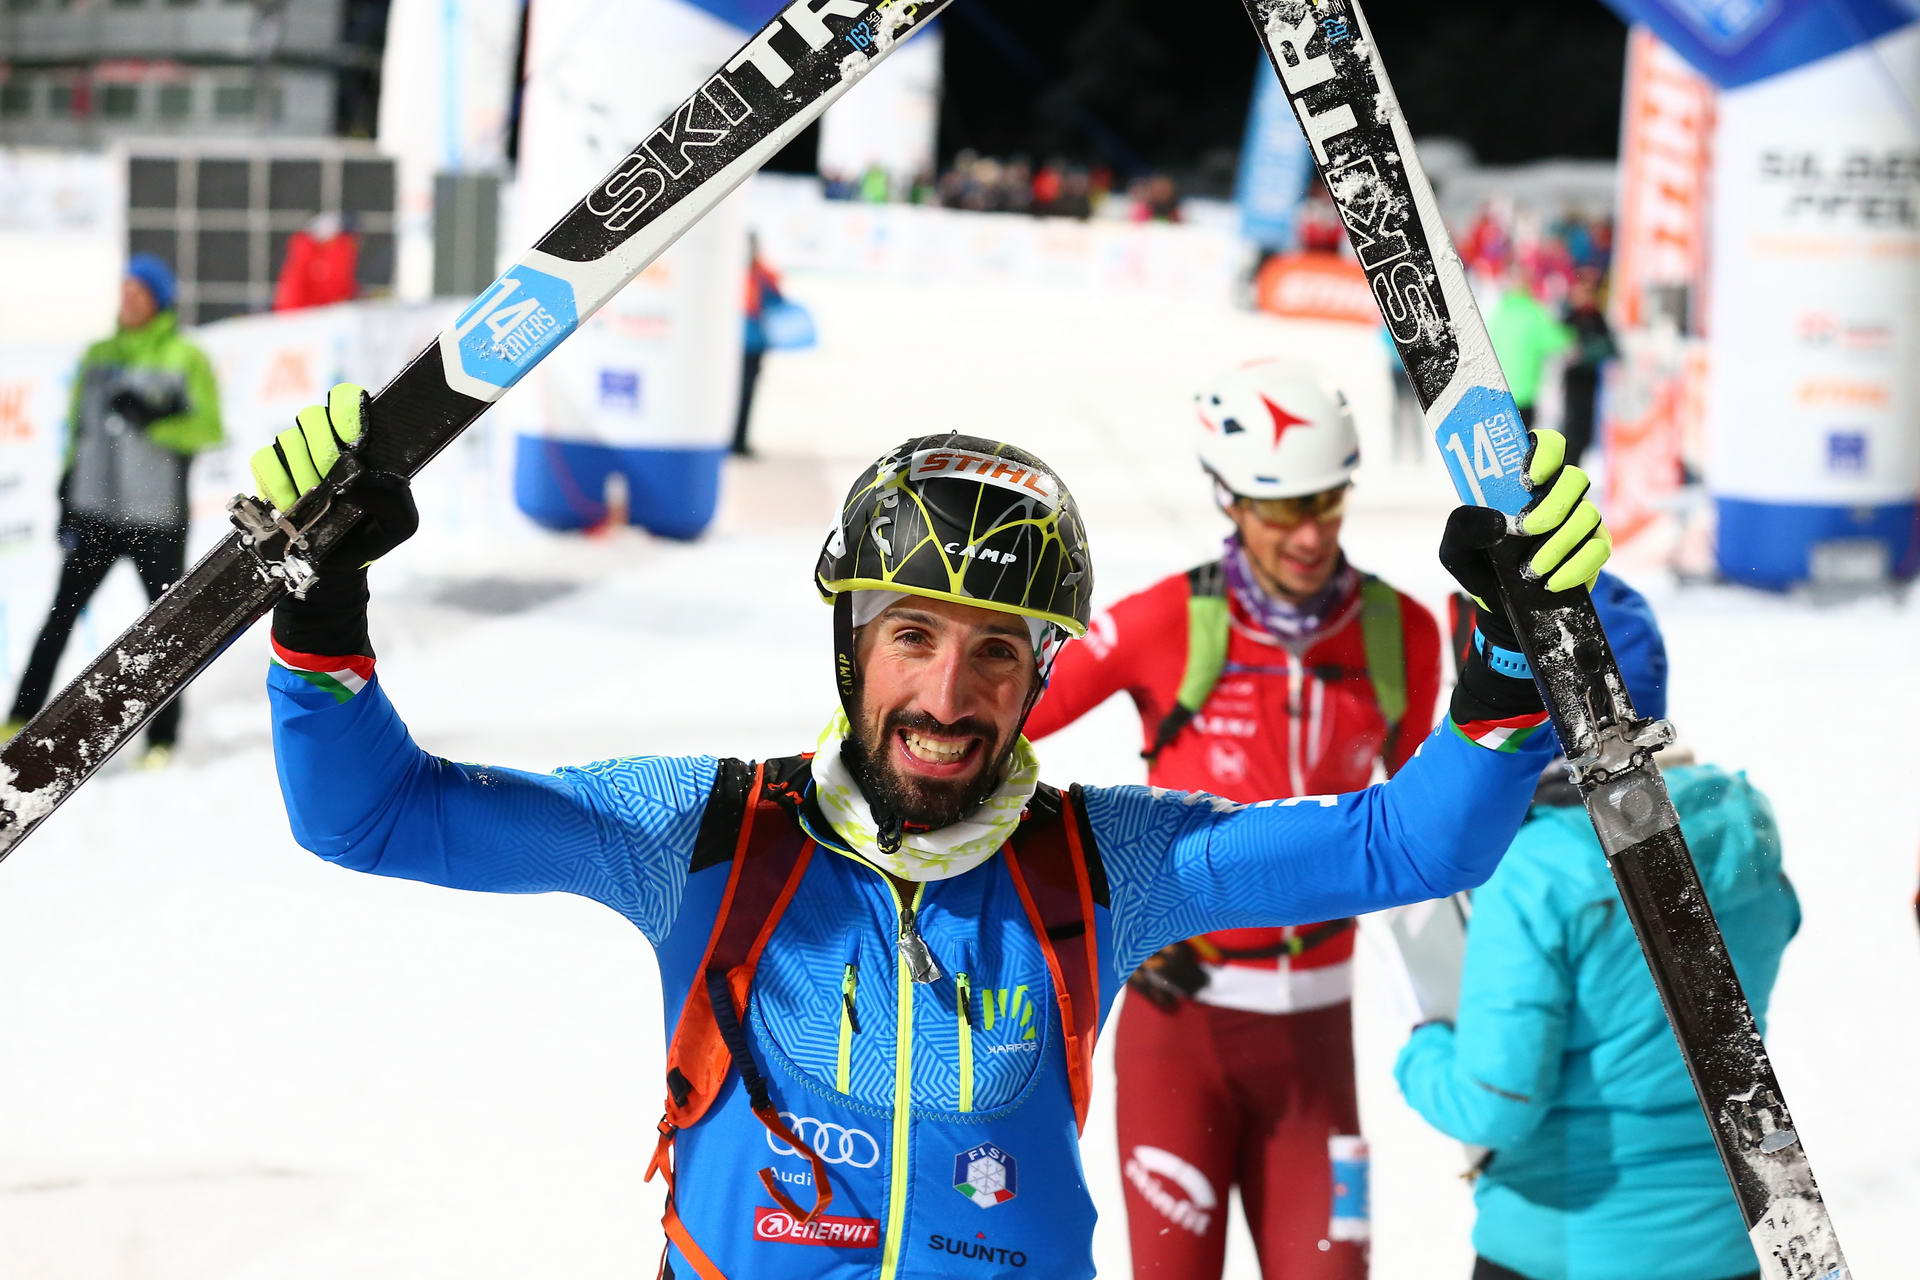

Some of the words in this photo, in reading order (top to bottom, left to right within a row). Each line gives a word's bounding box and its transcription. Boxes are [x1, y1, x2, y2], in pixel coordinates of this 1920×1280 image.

[845, 21, 874, 51] 162
[456, 278, 541, 342] 14
[502, 306, 556, 361] LAYERS
[1485, 413, 1522, 475] LAYERS
[918, 453, 1049, 497] STIHL
[1445, 421, 1504, 507] 14
[944, 542, 1016, 566] CAMP
[839, 653, 852, 695] CAMP
[968, 1146, 1006, 1164] FISI
[769, 1166, 812, 1187] Audi
[790, 1219, 876, 1243] ENERVIT
[928, 1234, 1027, 1268] SUUNTO
